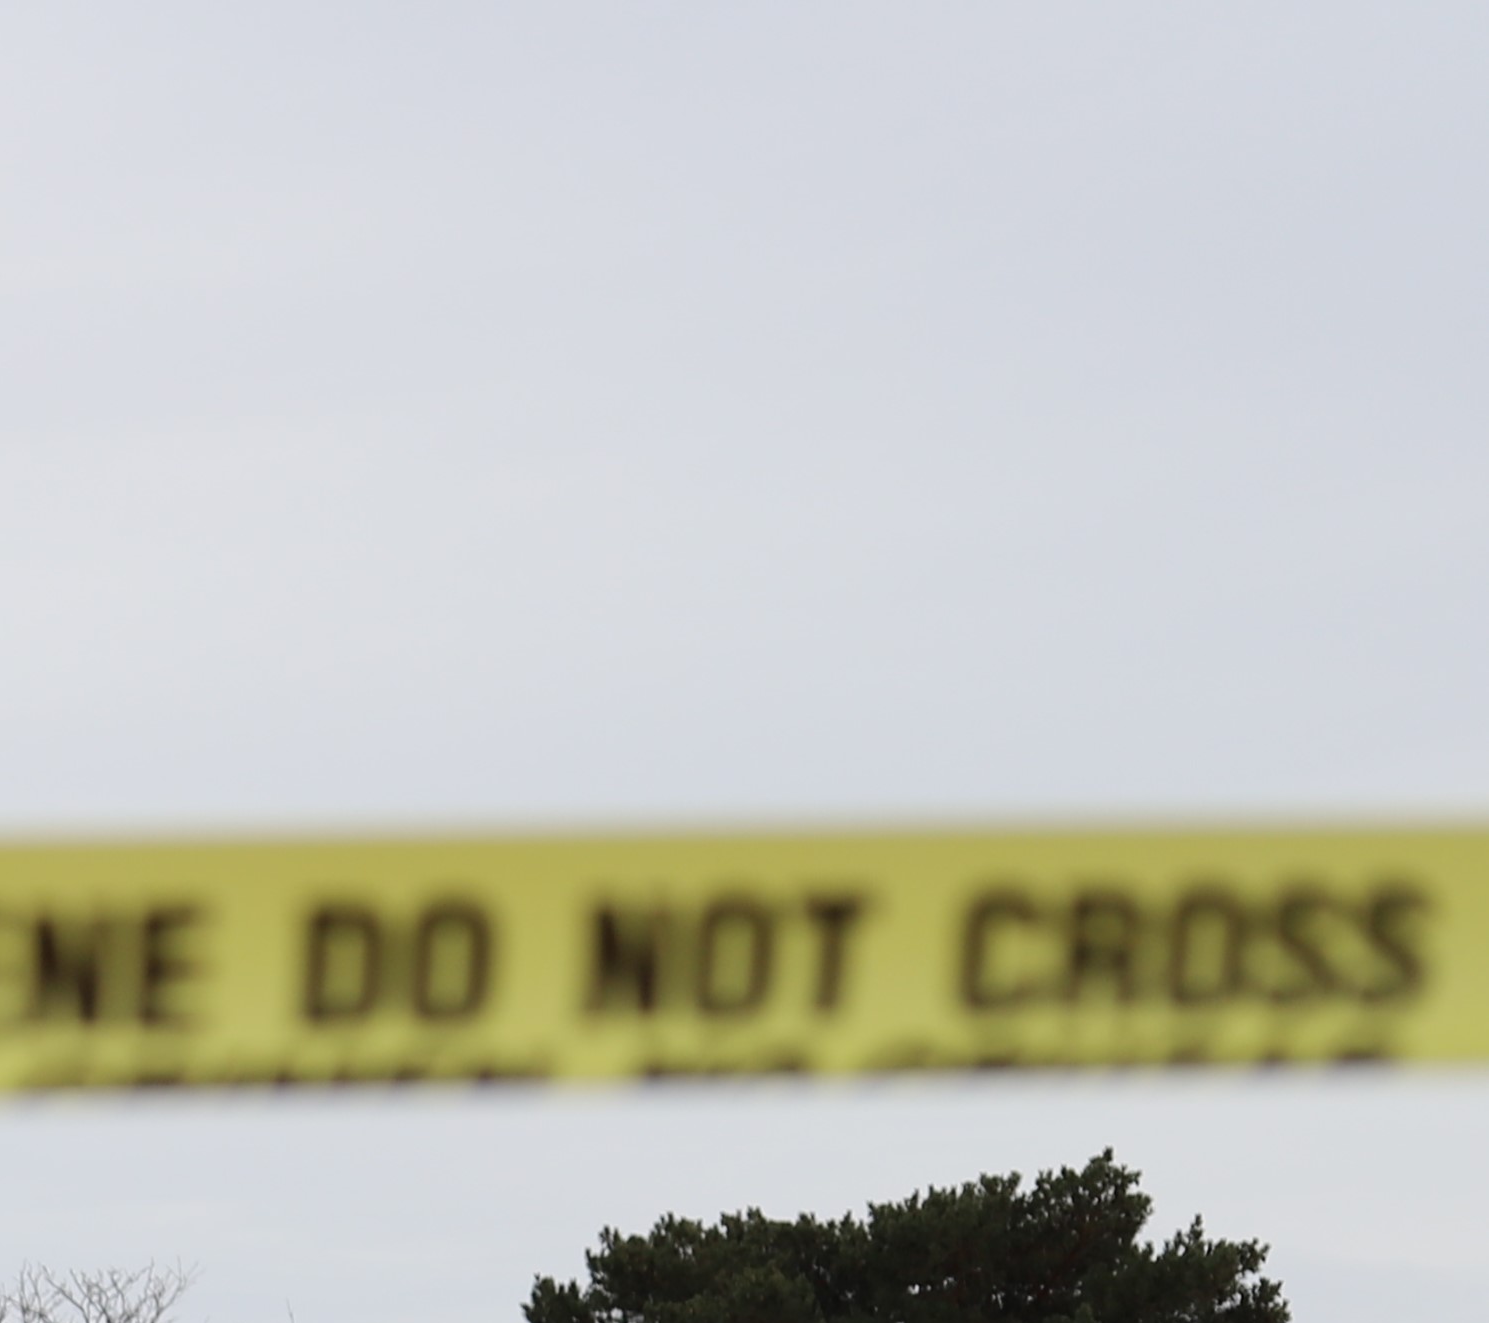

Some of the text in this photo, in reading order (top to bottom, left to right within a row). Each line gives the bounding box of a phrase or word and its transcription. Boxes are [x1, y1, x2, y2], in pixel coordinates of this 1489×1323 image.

[301, 900, 497, 1028] DO
[584, 896, 871, 1024] NOT
[958, 888, 1430, 1016] CROSS
